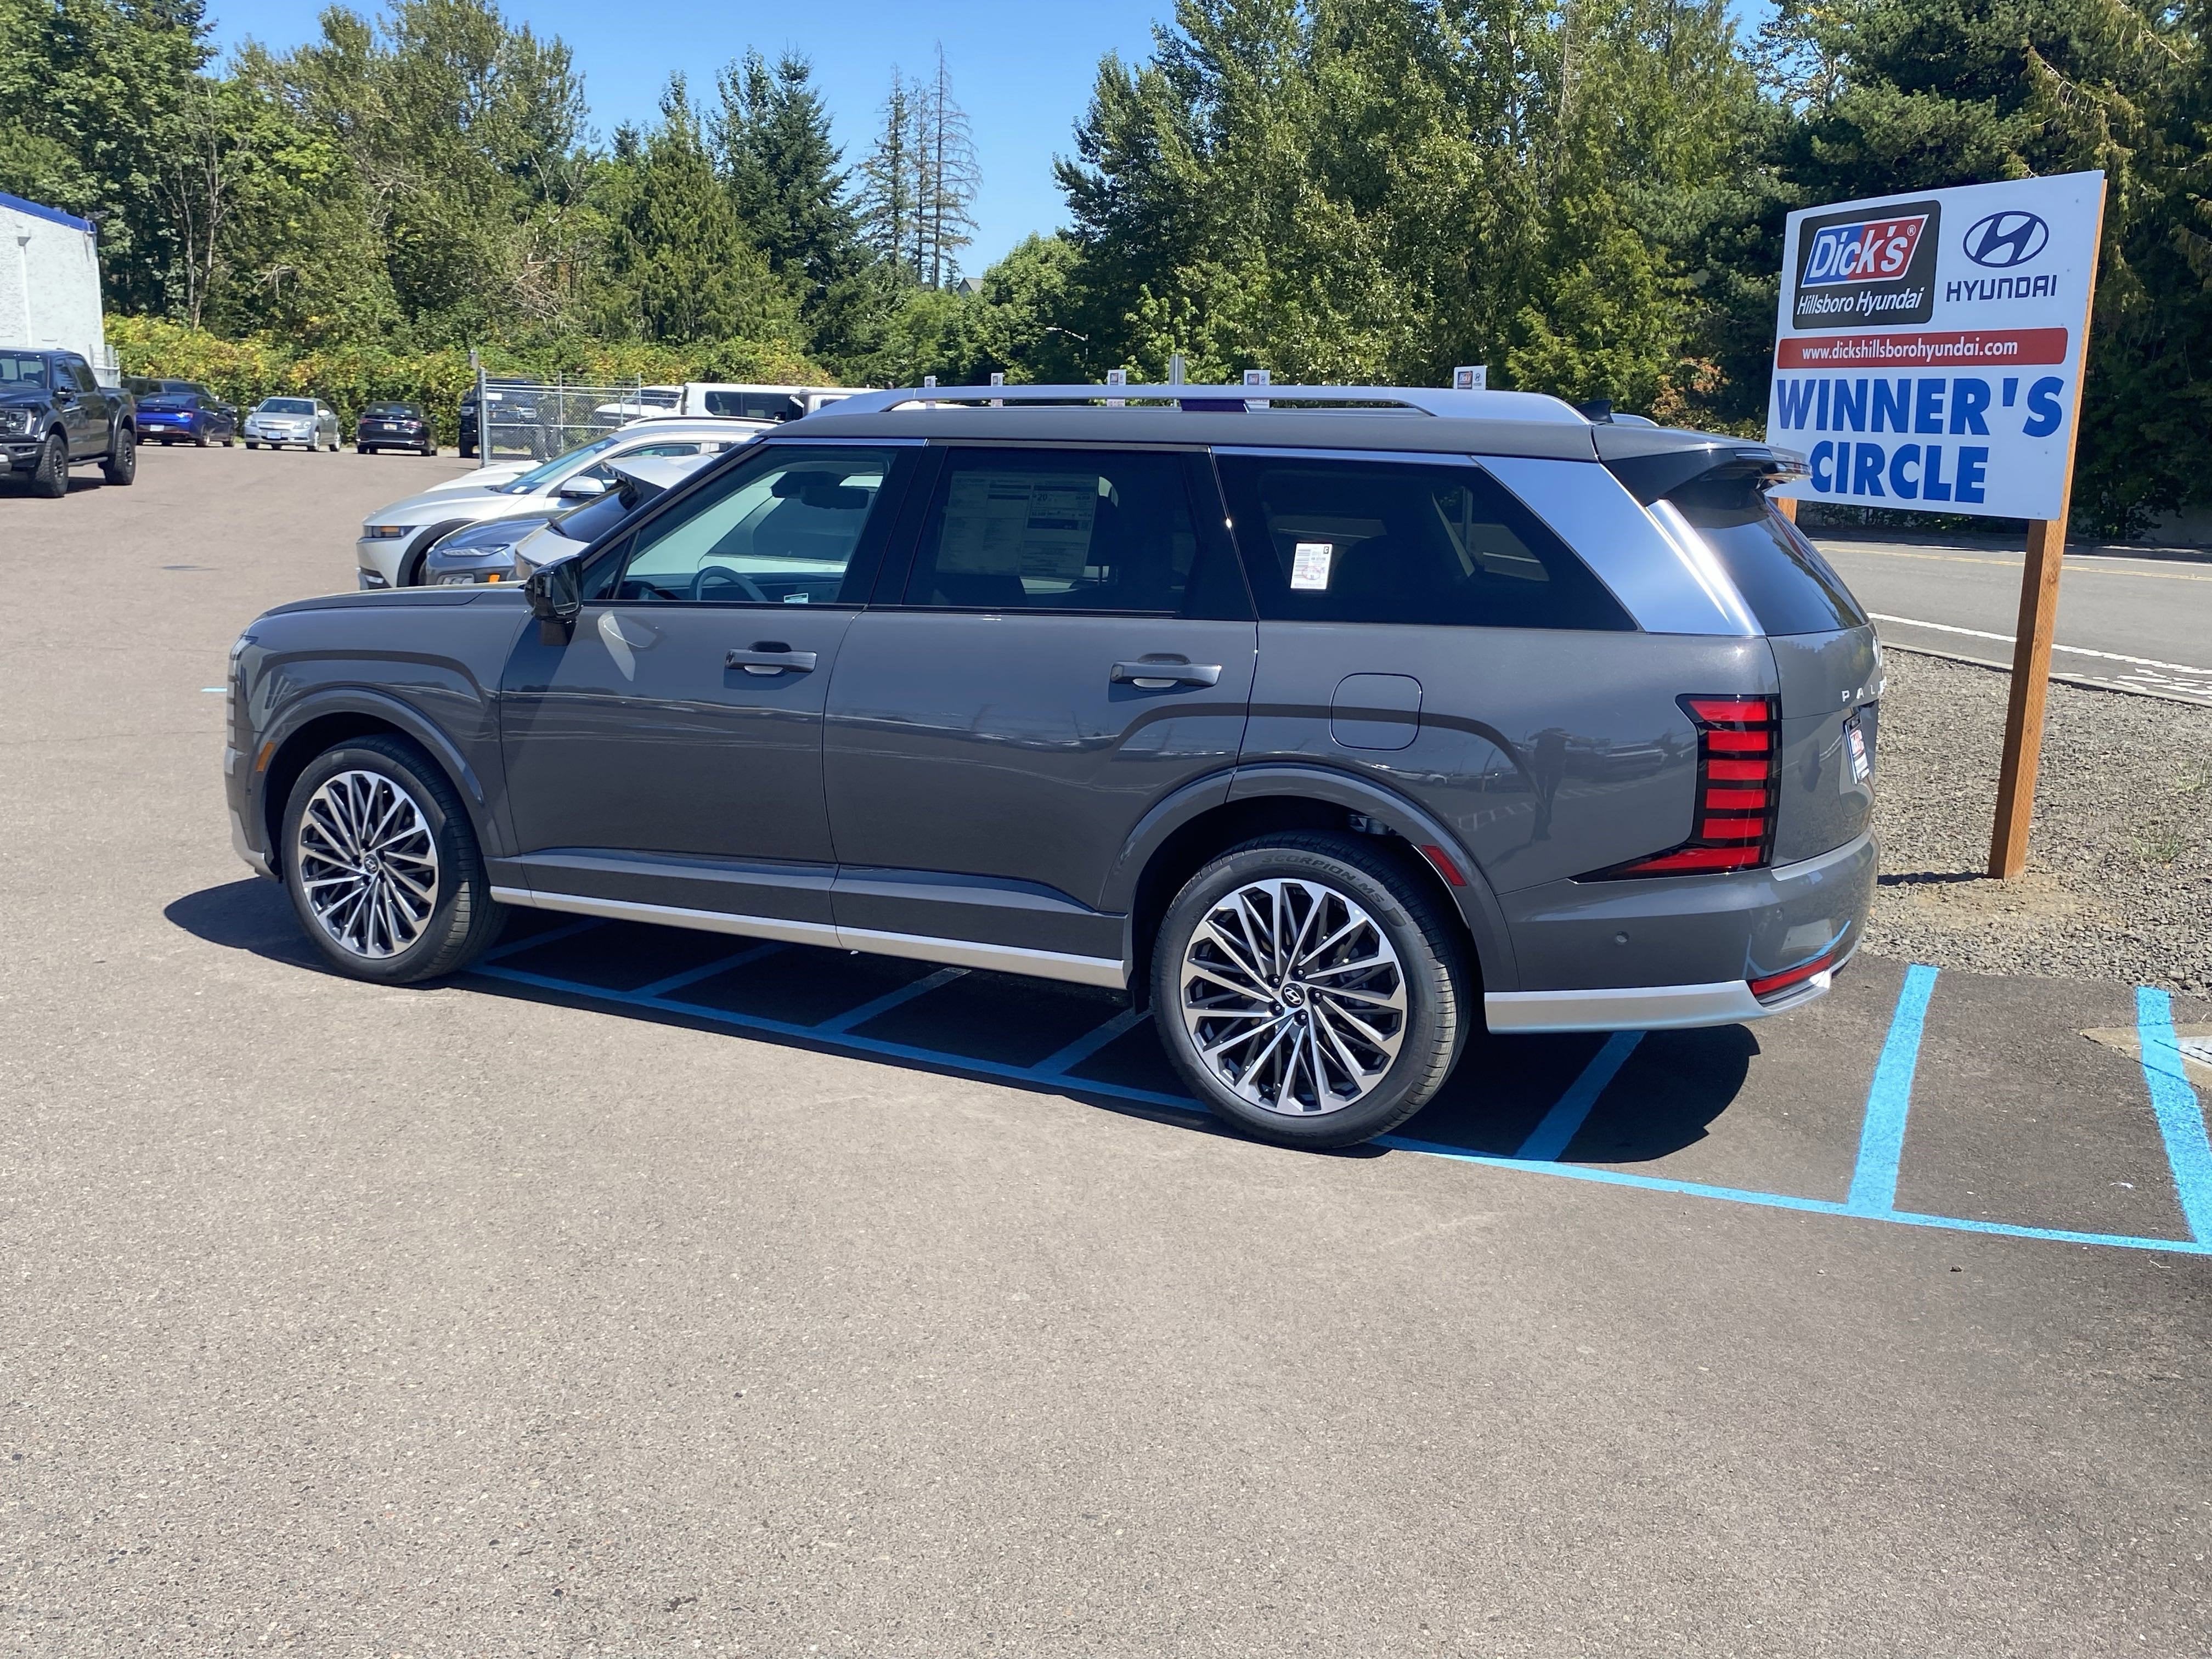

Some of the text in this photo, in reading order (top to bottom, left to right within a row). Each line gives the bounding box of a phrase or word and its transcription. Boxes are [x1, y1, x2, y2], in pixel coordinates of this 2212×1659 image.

[1797, 286, 1926, 317] Hillsboro Hyundai
[1946, 275, 2057, 302] HYUNDAI
[1802, 336, 2018, 362] www.dickshillsborohyundai.com
[1776, 376, 2064, 438] WINNER'S
[1810, 440, 1990, 504] CIRCLE
[1262, 855, 1357, 881] SCORPION
